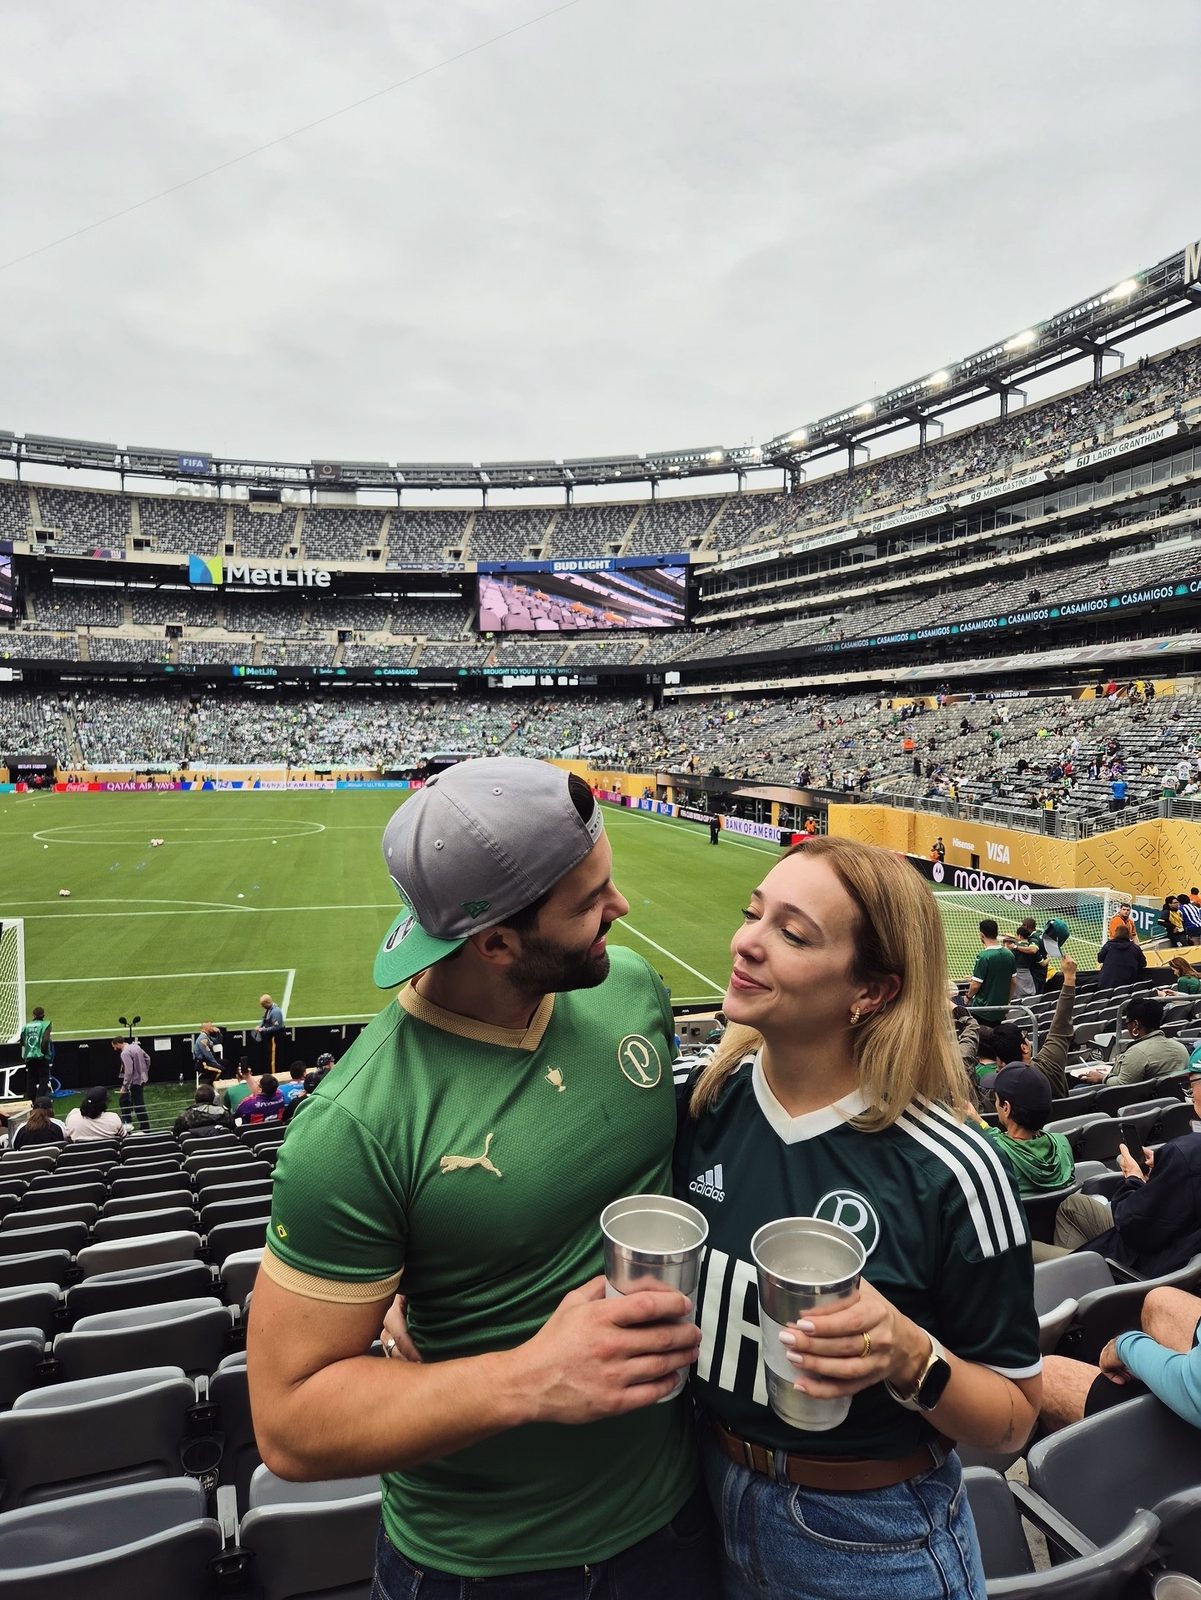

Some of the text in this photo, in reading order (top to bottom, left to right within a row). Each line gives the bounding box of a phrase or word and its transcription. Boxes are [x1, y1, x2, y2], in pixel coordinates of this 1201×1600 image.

[1076, 429, 1164, 468] 60 LARRY GRANTHAM
[183, 458, 203, 468] FIFA
[970, 474, 1037, 503] 99 MARK GASTINEAU
[227, 562, 331, 587] MetLife
[554, 559, 611, 571] BUD LIGHT
[840, 639, 869, 650] CASAMIGOS
[877, 633, 909, 645] CASAMIGOS
[917, 626, 950, 639] CASAMIGOS
[960, 618, 997, 633] CASAMIGOS
[1007, 609, 1048, 625] CASAMIGOS
[1060, 598, 1108, 616] CASAMIGOS
[1121, 586, 1173, 605] CASAMIGOS
[246, 666, 277, 676] MetLife
[107, 782, 136, 791] QATAR
[725, 817, 781, 841] BANK OF AMERIC
[952, 838, 975, 851] Hisense
[986, 840, 1010, 865] VISA
[954, 869, 1032, 906] motorola
[689, 1181, 725, 1202] adidas
